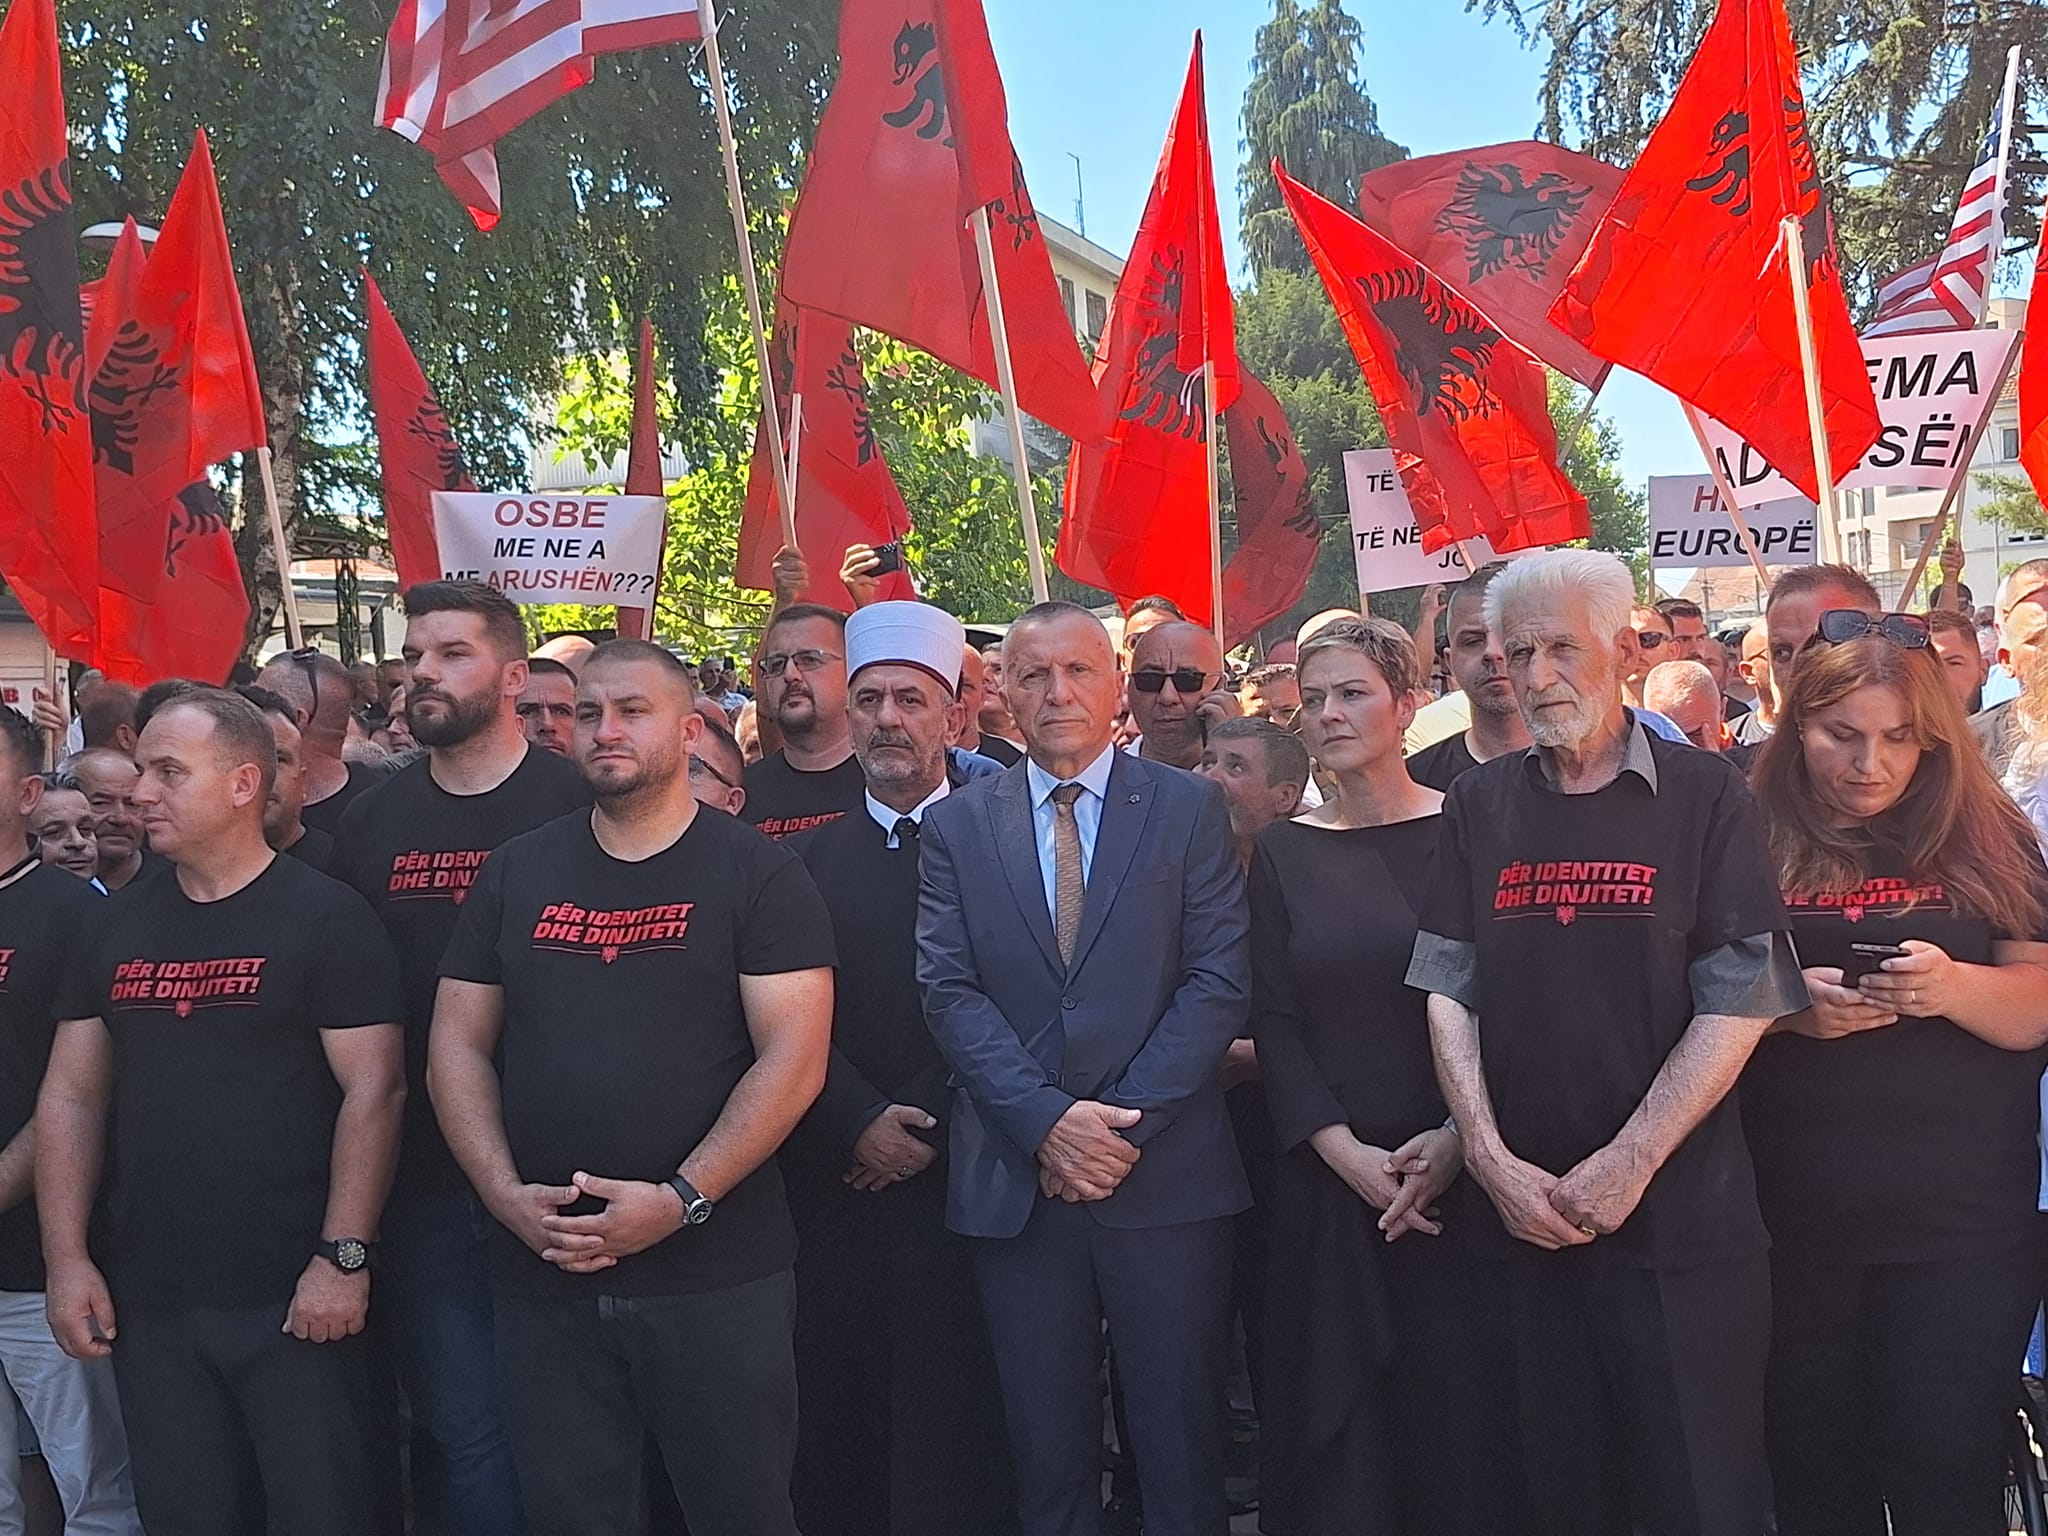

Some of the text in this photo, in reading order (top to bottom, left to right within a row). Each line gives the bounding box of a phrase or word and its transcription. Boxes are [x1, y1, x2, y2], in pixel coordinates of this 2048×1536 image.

[1366, 470, 1394, 493] TË
[494, 499, 608, 528] OSBE
[493, 537, 606, 560] ME NE A
[1356, 526, 1385, 551] TË
[1652, 520, 1814, 558] EUROPË
[487, 566, 655, 594] ARUSHËN???
[393, 850, 492, 871] PËR IDENT
[388, 871, 432, 892] DHE
[1498, 861, 1658, 886] PËR IDENTITET
[1494, 884, 1654, 910] DHE DINJITET!
[540, 903, 694, 926] PËR IDENTITET
[533, 921, 688, 944] DHE DINJITET!
[115, 957, 266, 980] PËR IDENTITET
[111, 976, 261, 1000] DHE DINJITET!
